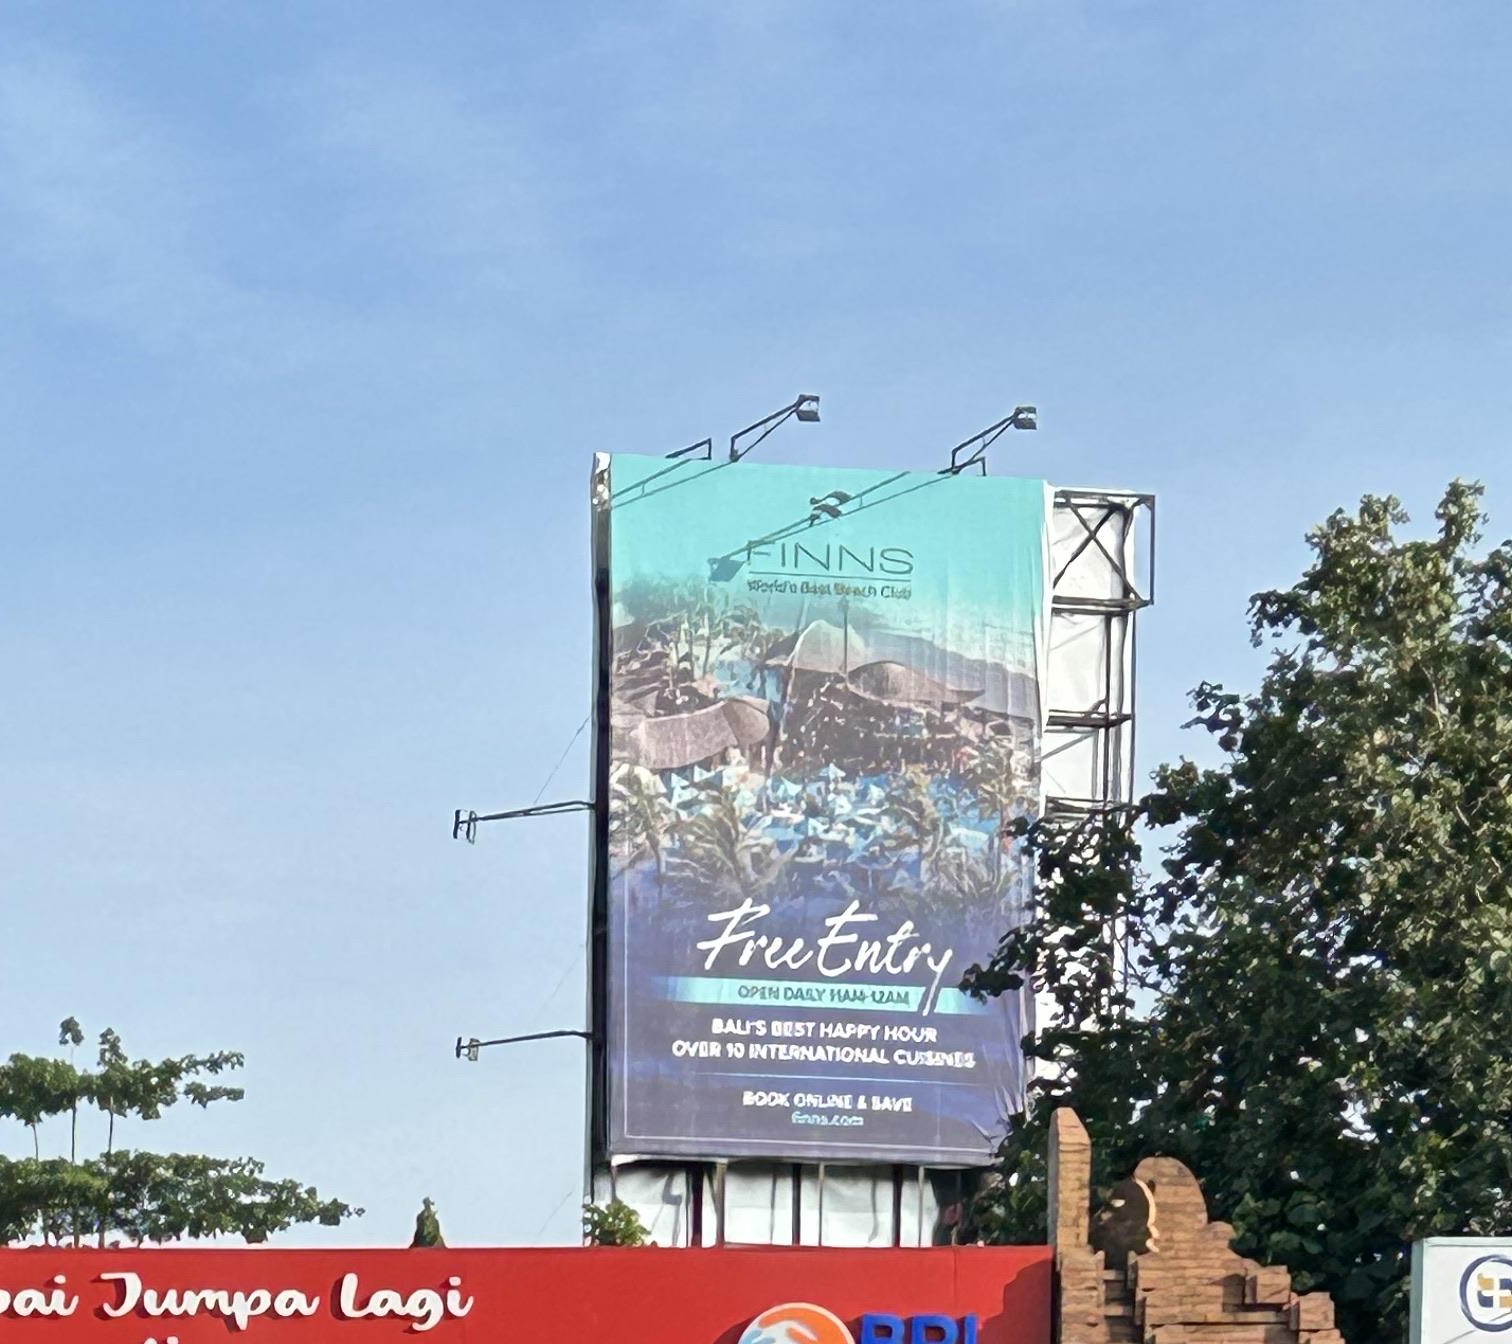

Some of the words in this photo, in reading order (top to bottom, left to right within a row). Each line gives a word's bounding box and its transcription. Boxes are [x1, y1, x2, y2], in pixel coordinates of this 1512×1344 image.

[745, 541, 914, 575] FINNS
[696, 897, 814, 970] Free
[816, 899, 953, 1016] Entry
[819, 1022, 881, 1041] HAPPY
[883, 1027, 937, 1043] HOUR
[671, 1040, 721, 1058] OVER
[748, 1043, 890, 1065] INTERNATIONAL
[742, 1090, 790, 1107] BOOK
[99, 1270, 320, 1331] Jumpa
[340, 1272, 475, 1332] Lagi
